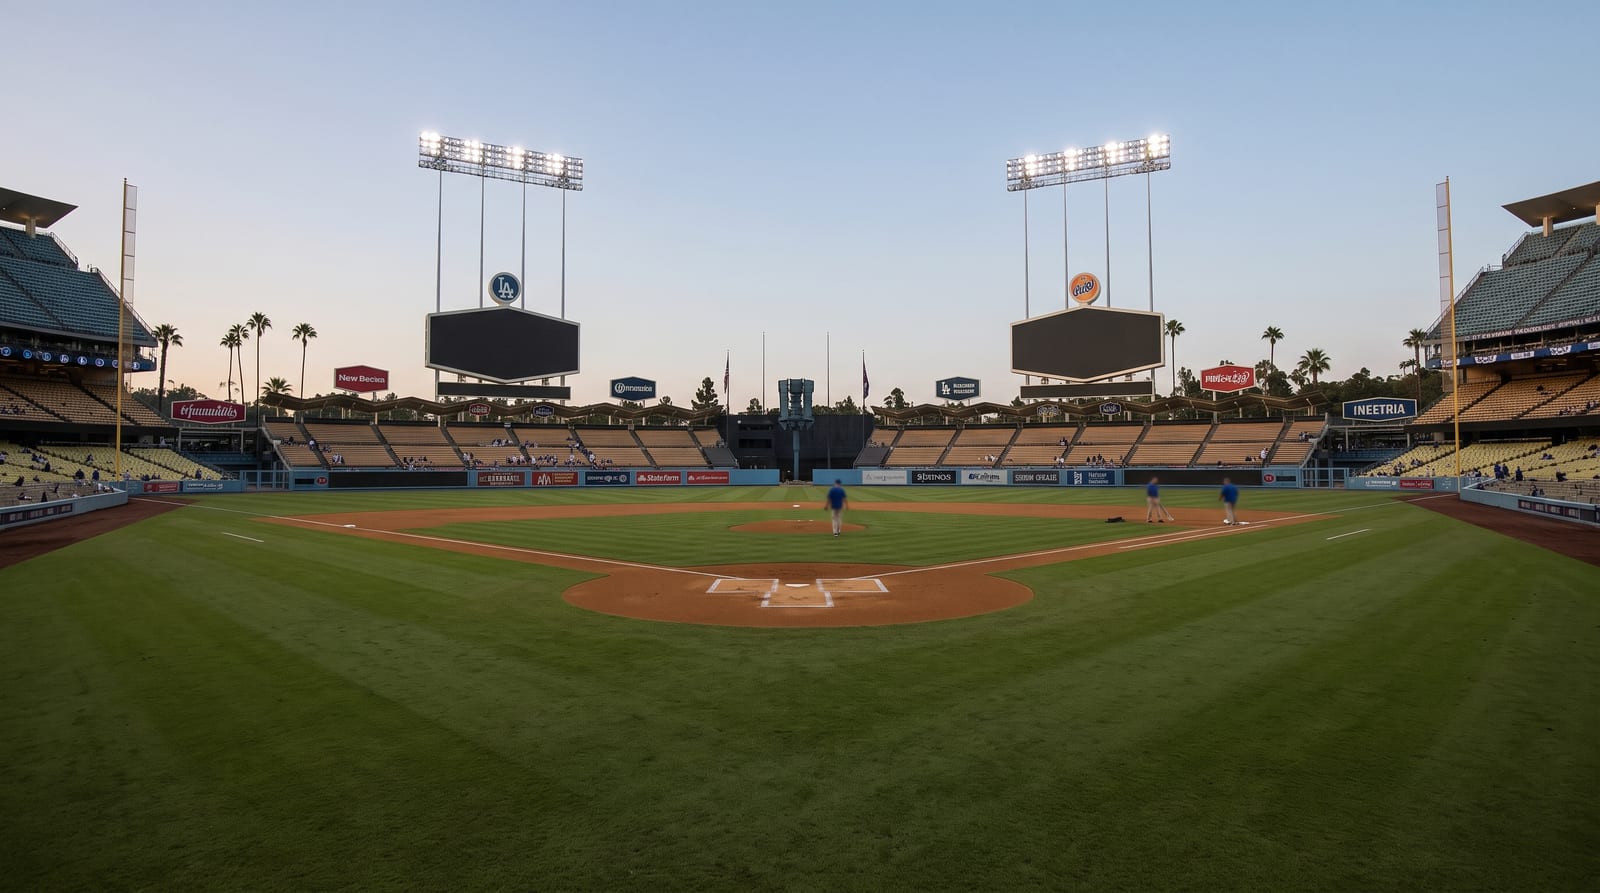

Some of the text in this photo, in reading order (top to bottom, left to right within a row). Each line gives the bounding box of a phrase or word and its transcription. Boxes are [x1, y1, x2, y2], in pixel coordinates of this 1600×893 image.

[498, 277, 514, 299] LA
[338, 374, 358, 382] New
[1353, 403, 1406, 416] INEETRIA
